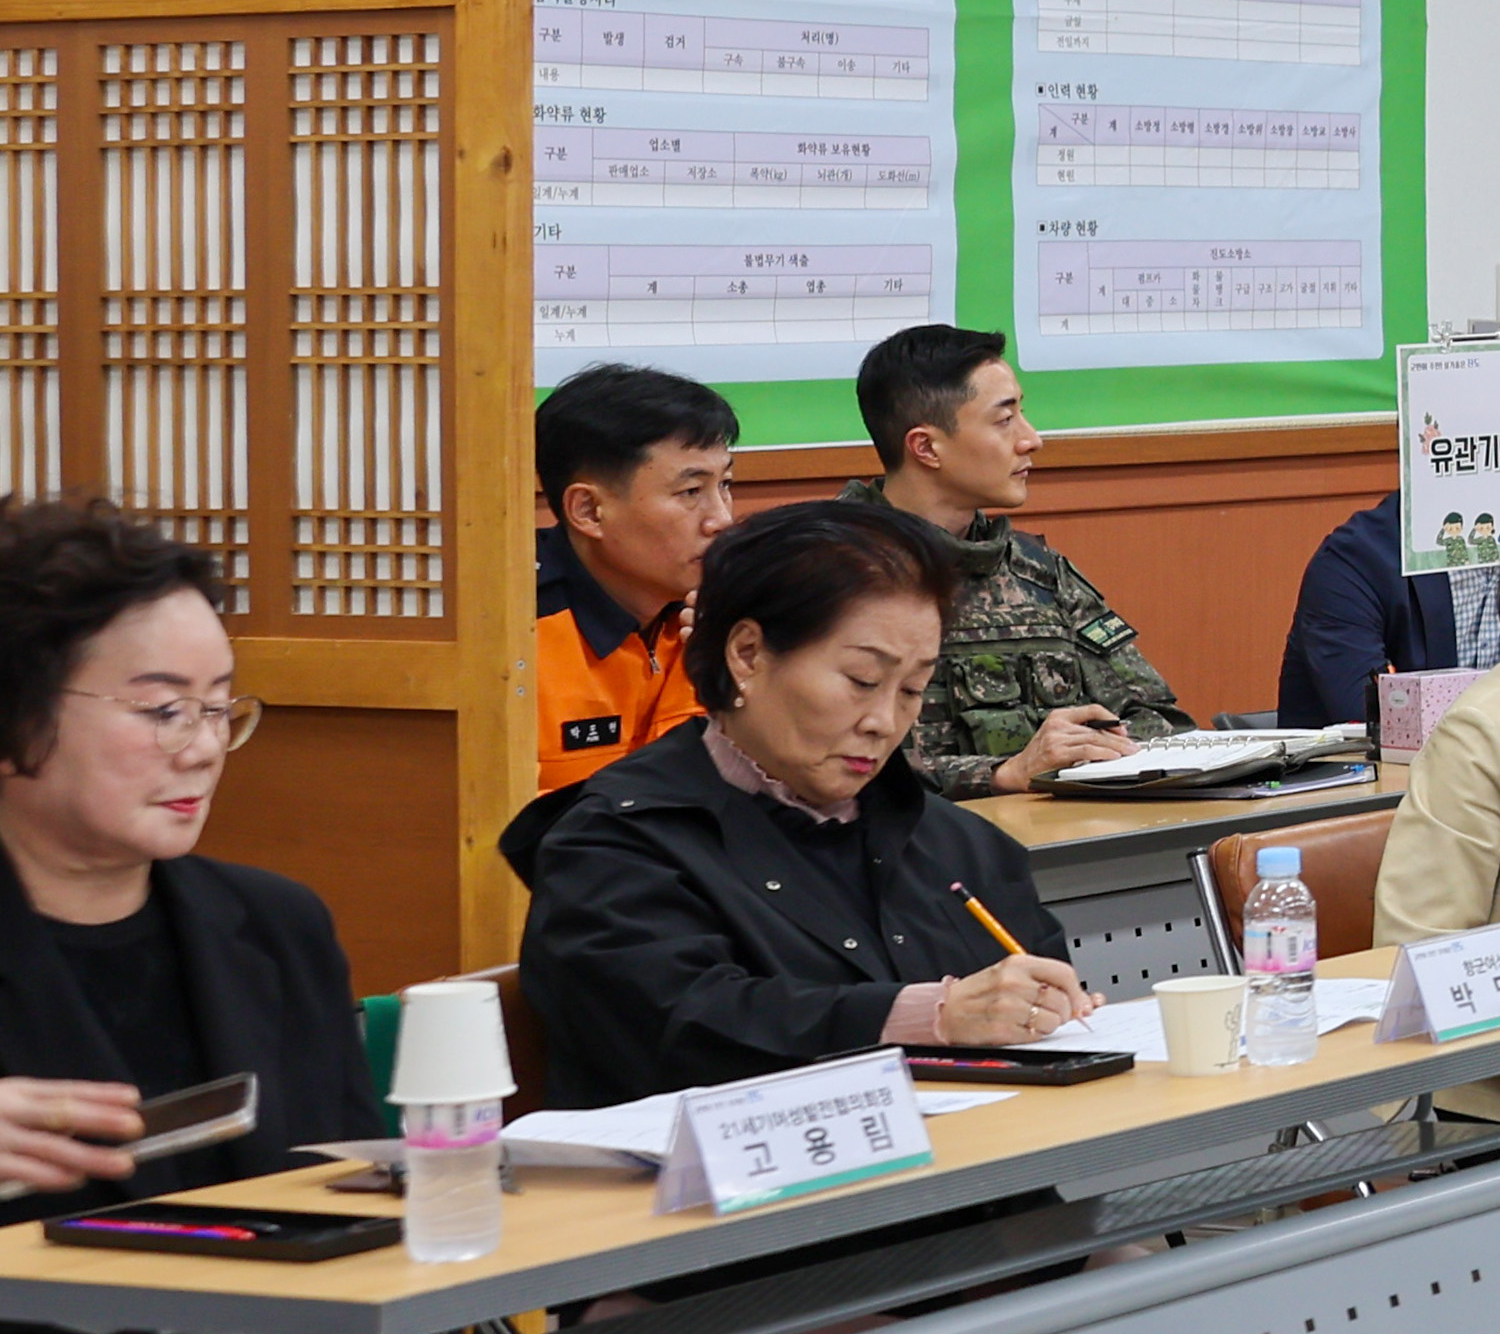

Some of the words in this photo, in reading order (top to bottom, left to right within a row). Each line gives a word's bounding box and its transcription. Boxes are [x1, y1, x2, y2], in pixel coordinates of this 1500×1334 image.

[538, 27, 562, 43] 구분
[602, 31, 625, 47] 발생
[664, 35, 686, 50] 검거
[800, 31, 840, 46] 처리(명)
[723, 53, 744, 67] 구속
[892, 60, 911, 74] 기타
[1048, 83, 1071, 99] 인력
[1075, 83, 1099, 100] 현황
[533, 104, 575, 124] 화약류
[579, 106, 607, 125] 현황
[1071, 112, 1089, 126] 구분
[649, 138, 681, 153] 업소별
[796, 142, 828, 157] 화약류
[830, 143, 871, 158] 보유현황
[544, 146, 568, 162] 구분
[608, 164, 650, 179] 판매업소
[686, 166, 717, 179] 저장소
[534, 223, 562, 242] 기타
[1048, 219, 1072, 237] 차량
[1076, 219, 1099, 237] 현황
[743, 253, 786, 268] 불법무기
[788, 253, 809, 268] 색출
[553, 265, 577, 280] 구분
[1054, 271, 1074, 285] 구분
[646, 280, 658, 295] 계
[882, 277, 904, 292] 기타
[1449, 981, 1477, 1015] 박
[743, 1141, 779, 1178] 고
[803, 1126, 837, 1167] 용
[860, 1110, 895, 1154] 림
